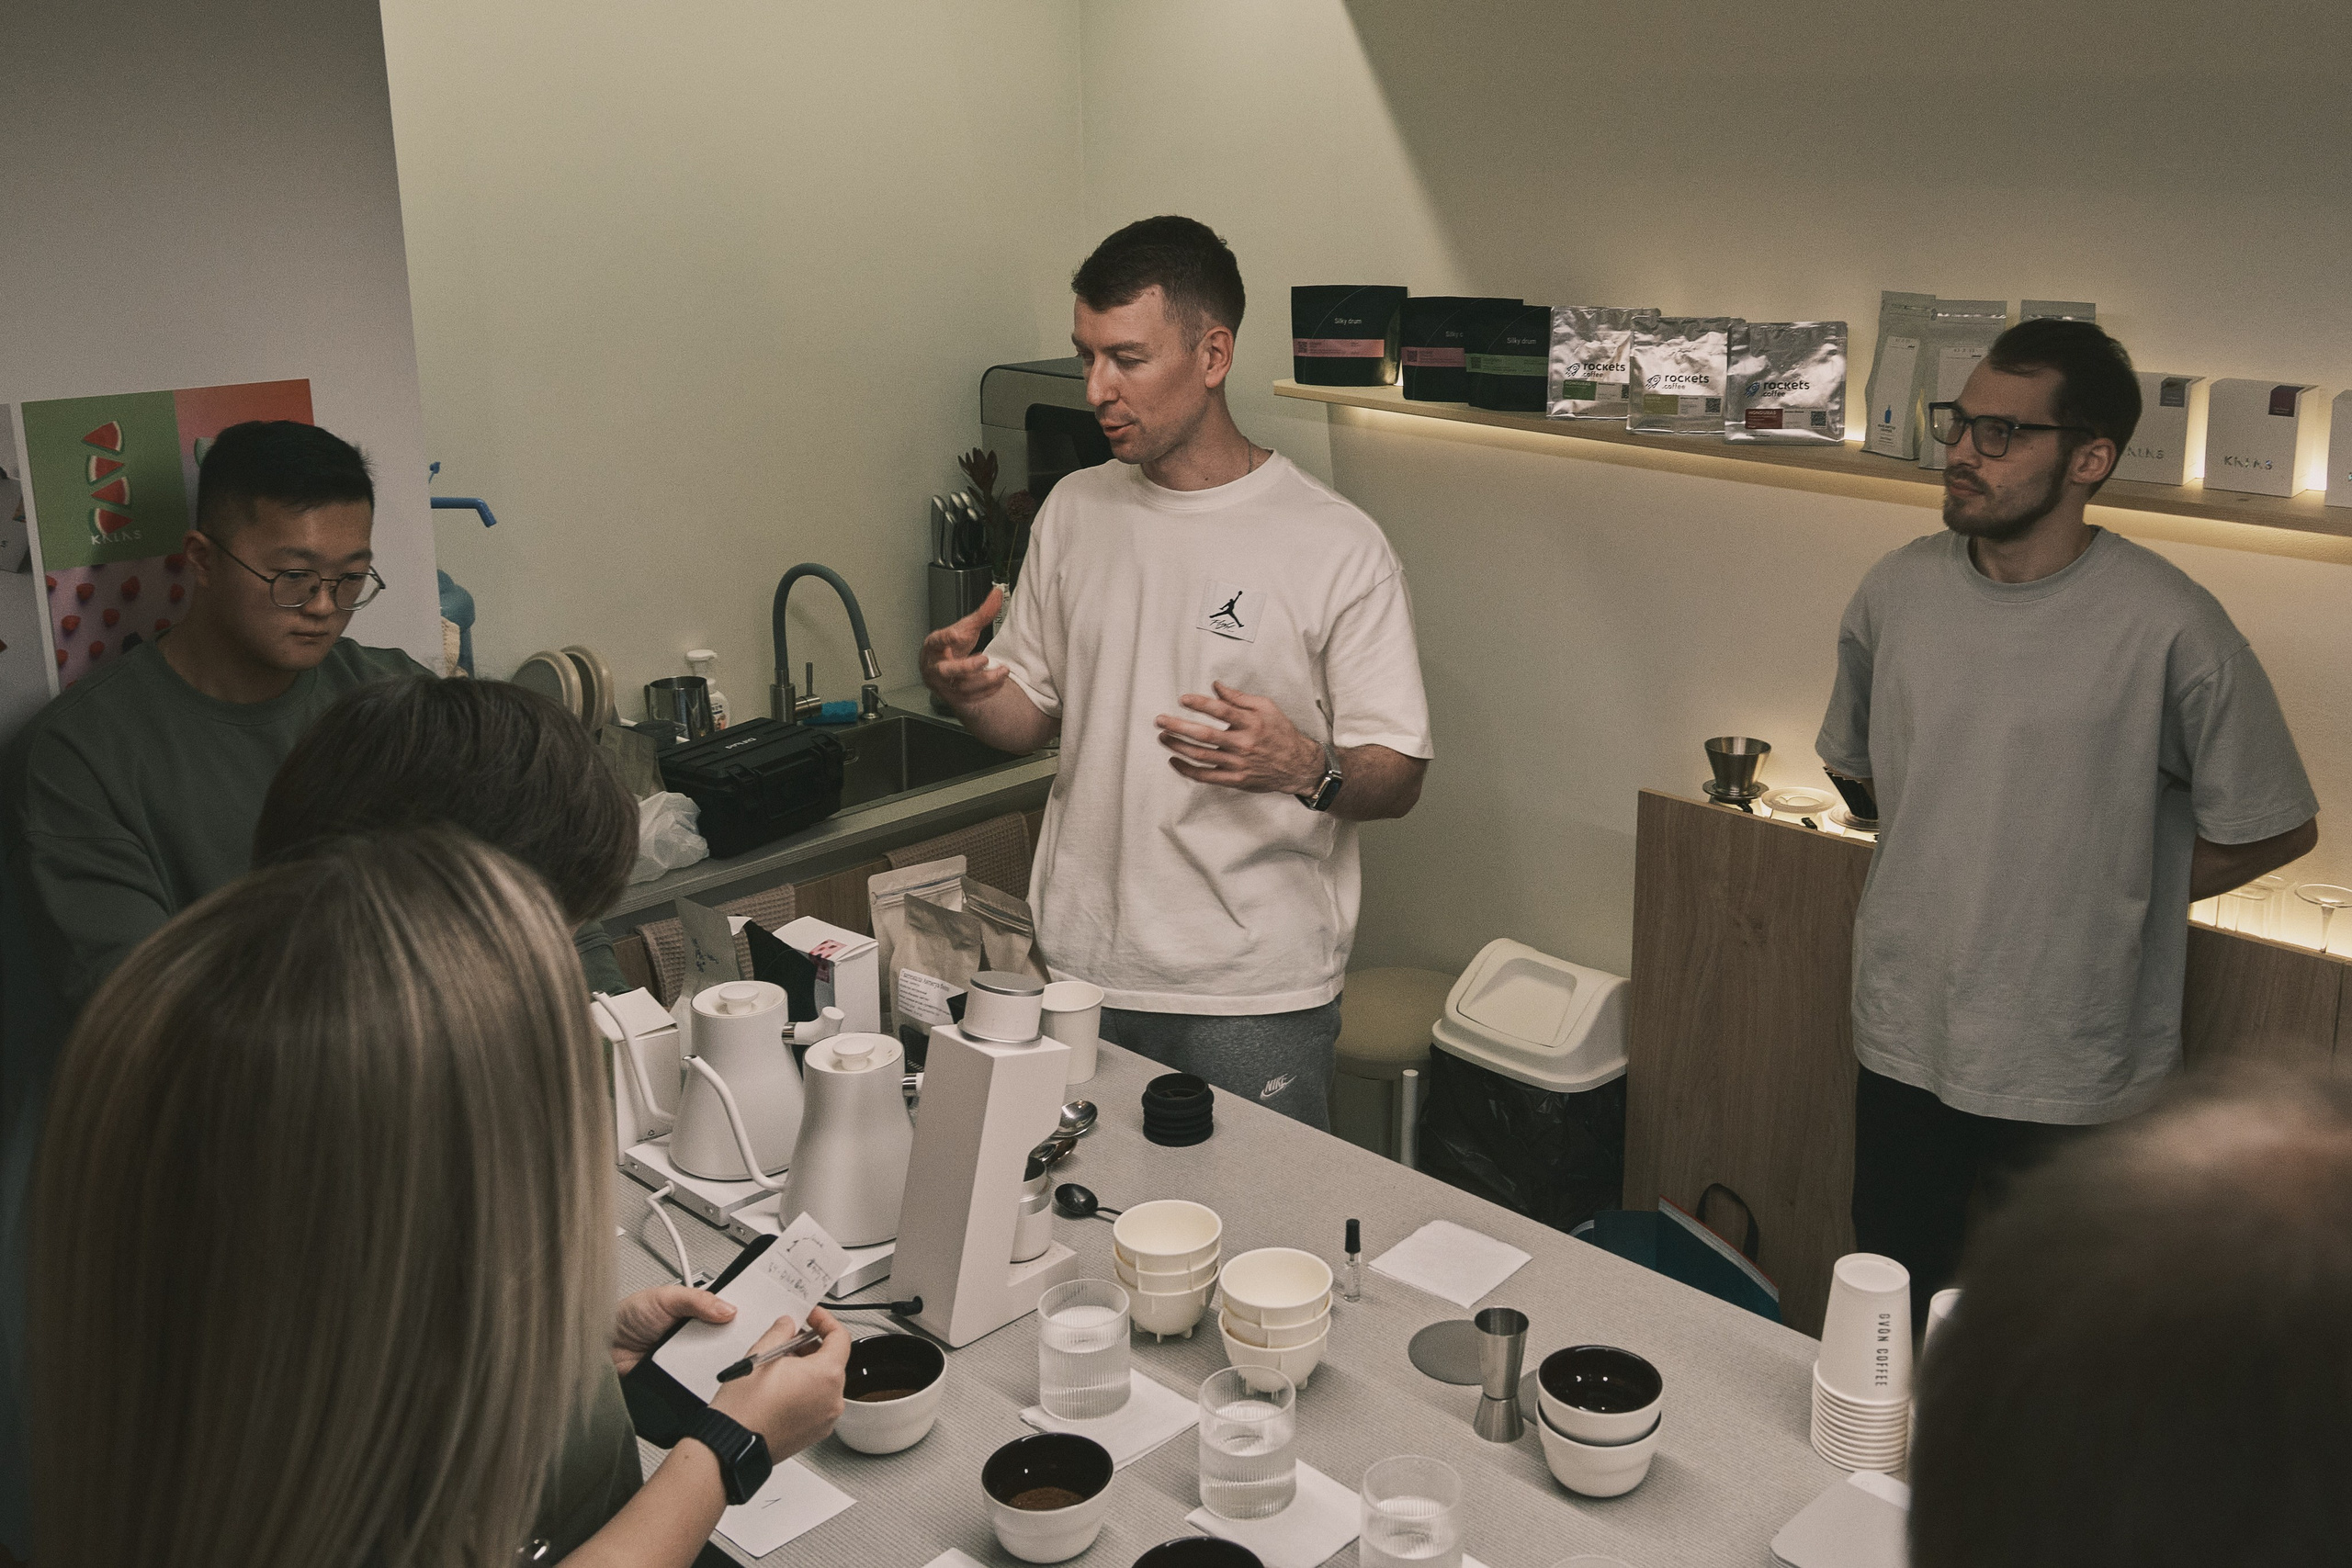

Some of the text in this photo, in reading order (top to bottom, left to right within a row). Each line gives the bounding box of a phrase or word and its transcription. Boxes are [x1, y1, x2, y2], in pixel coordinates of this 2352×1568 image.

[1334, 317, 1347, 325] Silky
[1507, 337, 1521, 345] Silky
[1583, 362, 1626, 372] rockets
[1664, 374, 1710, 384] rockets
[1764, 379, 1810, 390] rockets
[1875, 1348, 1889, 1386] COFFEE
